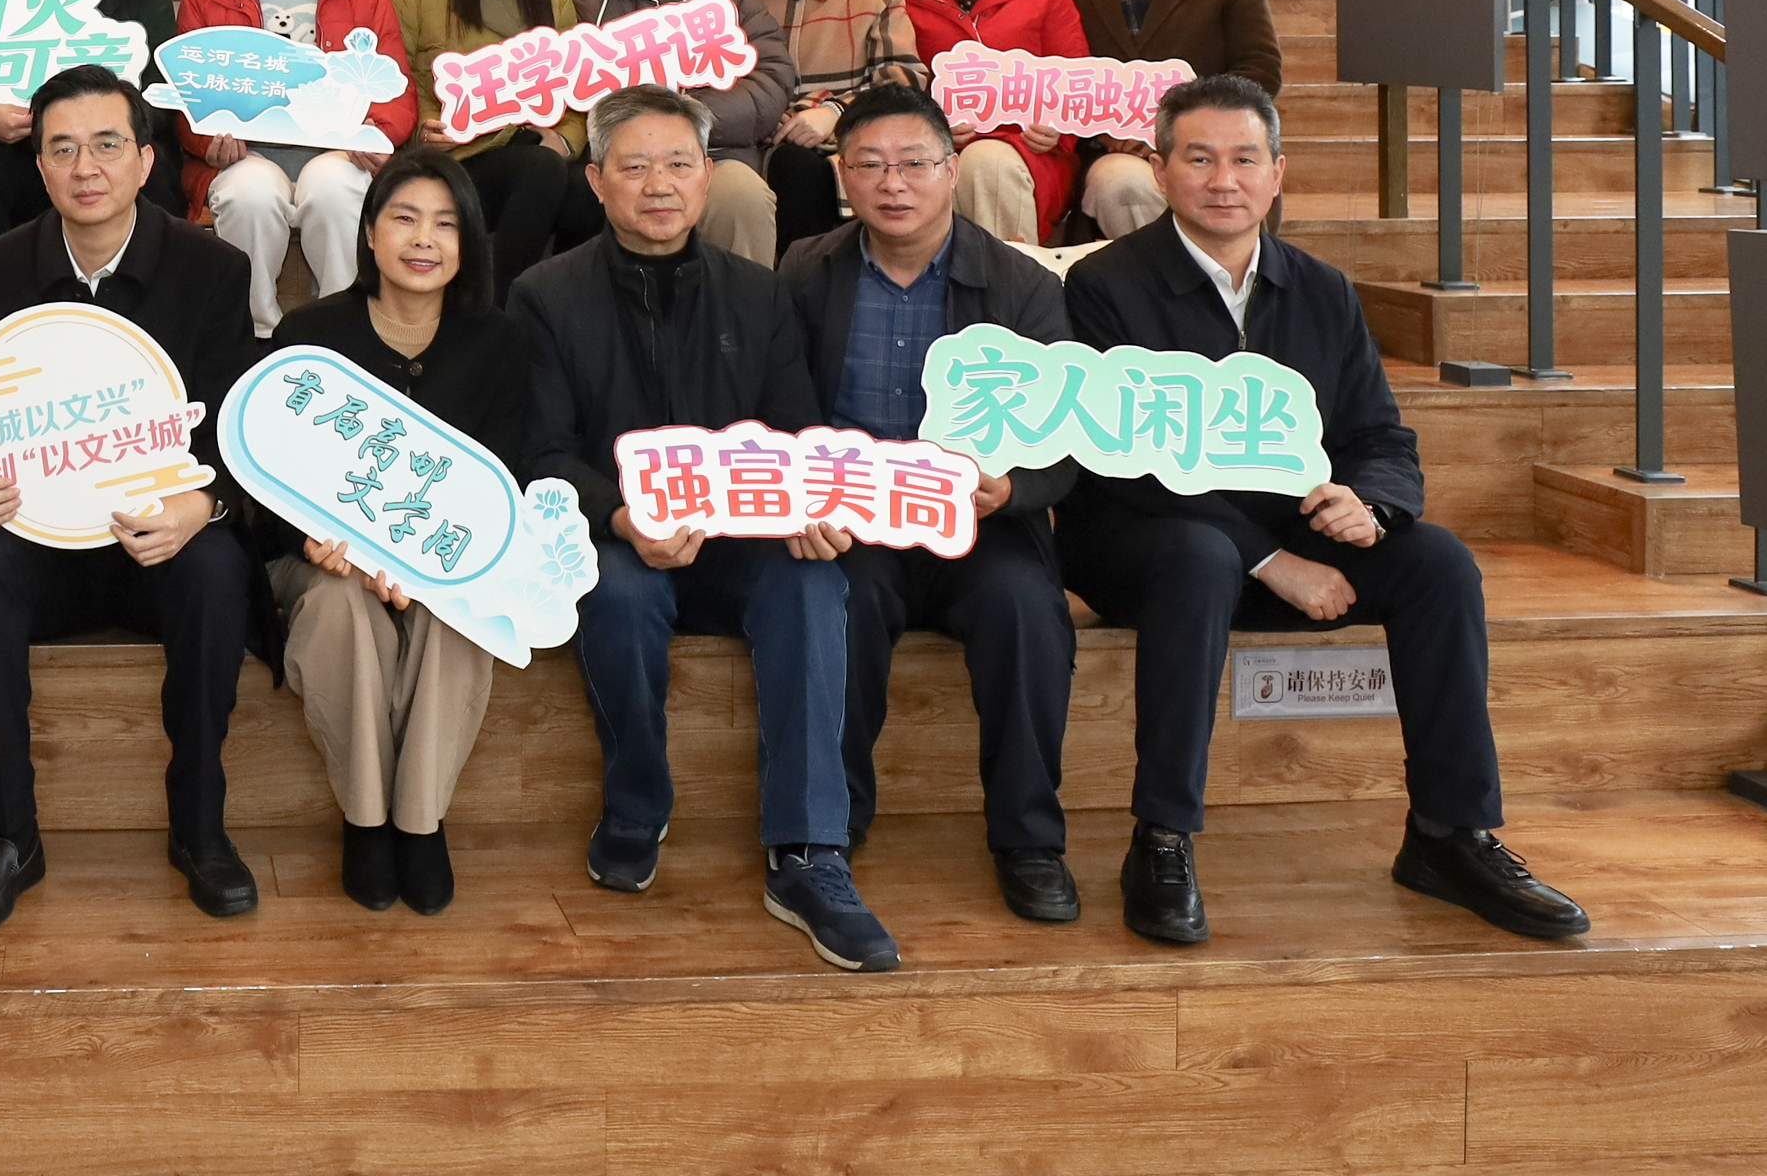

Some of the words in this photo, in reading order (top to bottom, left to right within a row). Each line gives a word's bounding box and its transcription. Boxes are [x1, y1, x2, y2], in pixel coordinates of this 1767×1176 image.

[175, 70, 288, 99] 文脉流淌
[177, 45, 291, 74] 运河名城
[444, 14, 749, 134] 汪学公开课
[283, 370, 453, 485] 首届高邮
[943, 348, 1308, 475] 家人闲坐
[336, 470, 474, 574] 文学周
[634, 439, 964, 539] 强富美高
[1287, 668, 1387, 693] 请保持安静
[1298, 694, 1326, 703] Please
[1329, 694, 1351, 703] Keep
[1353, 693, 1375, 703] Quiet
